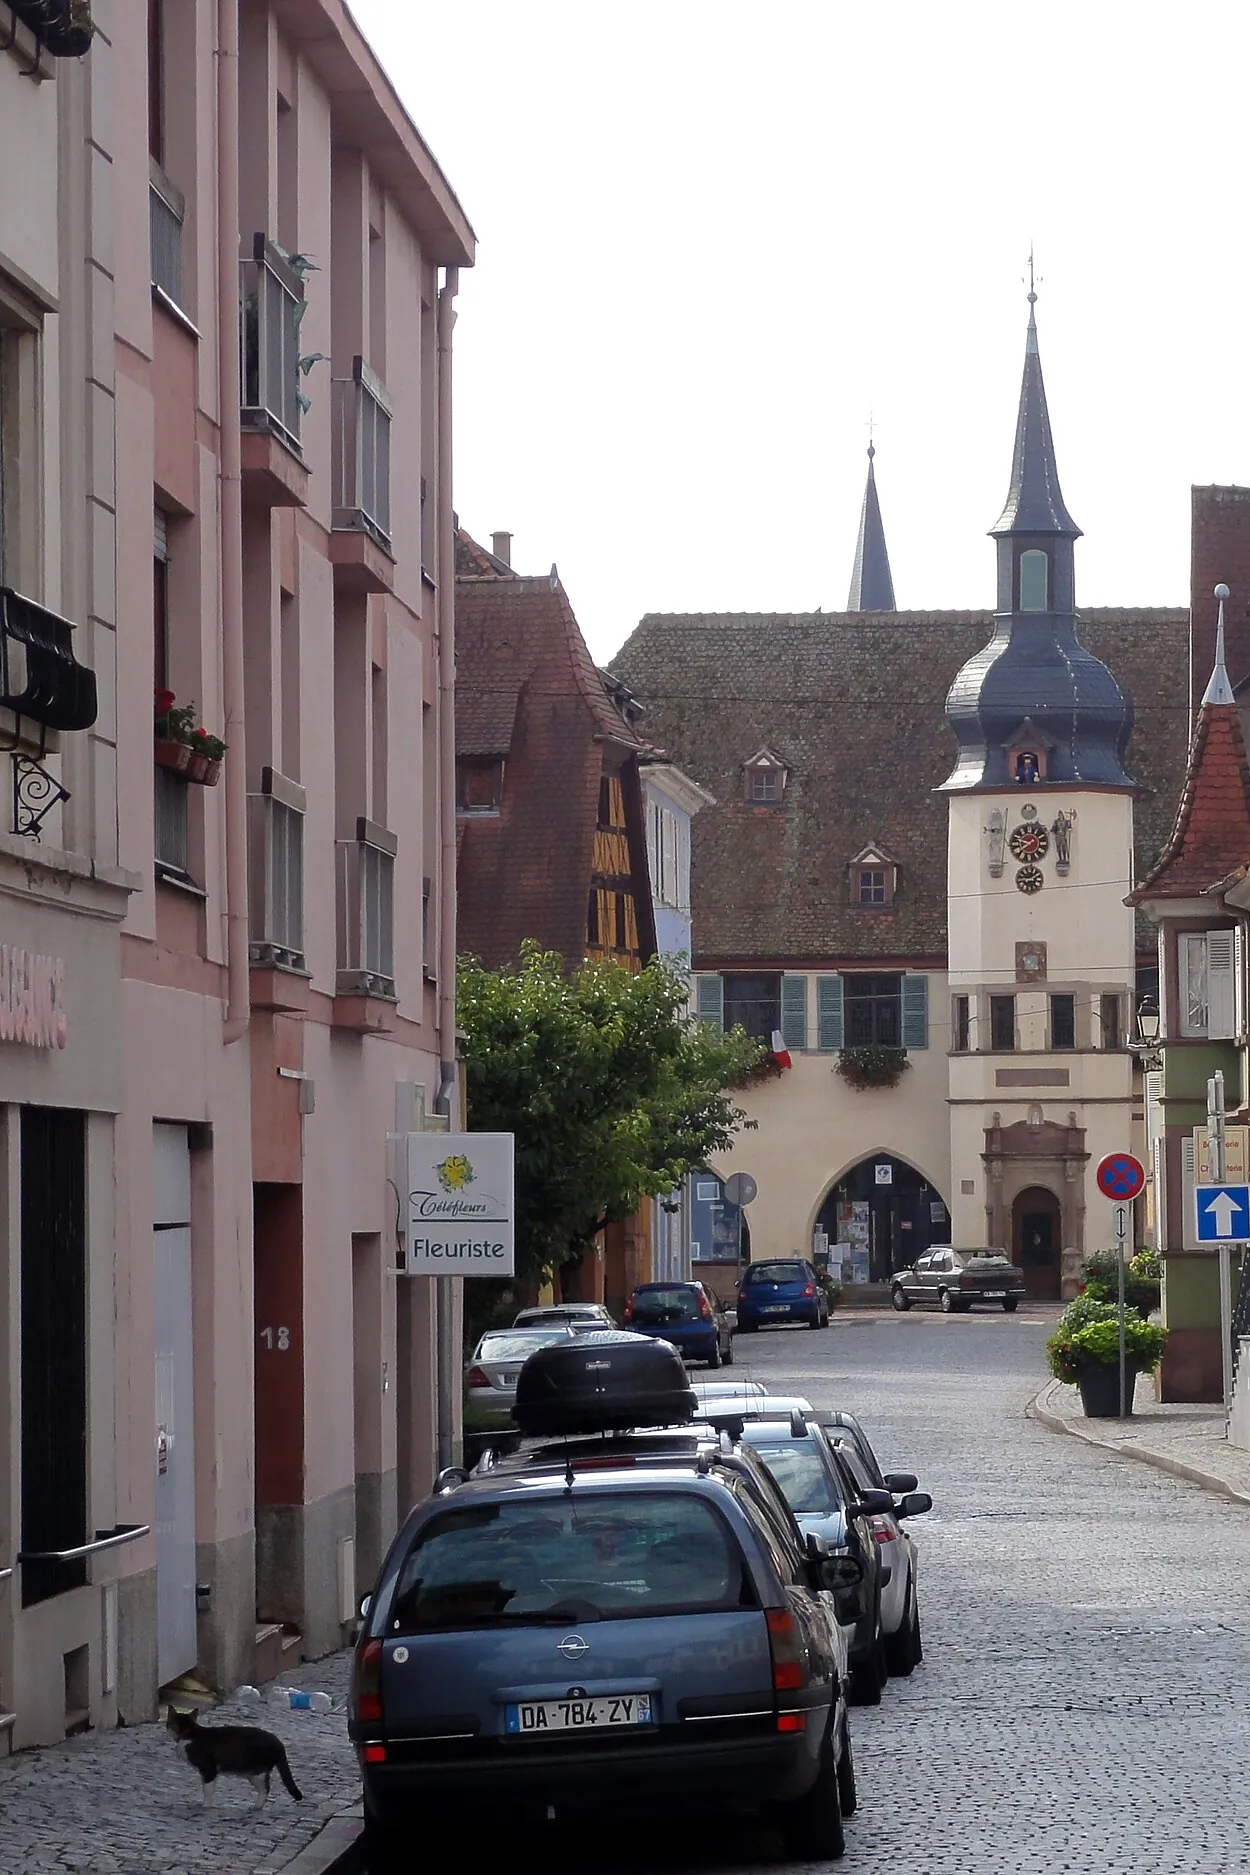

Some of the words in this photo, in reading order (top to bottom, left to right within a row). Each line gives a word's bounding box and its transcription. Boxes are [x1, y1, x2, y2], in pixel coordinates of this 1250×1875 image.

[409, 1191, 487, 1216] Téléfleurs
[413, 1239, 505, 1258] Fleuriste
[260, 1326, 289, 1350] 18
[638, 1709, 650, 1721] 67
